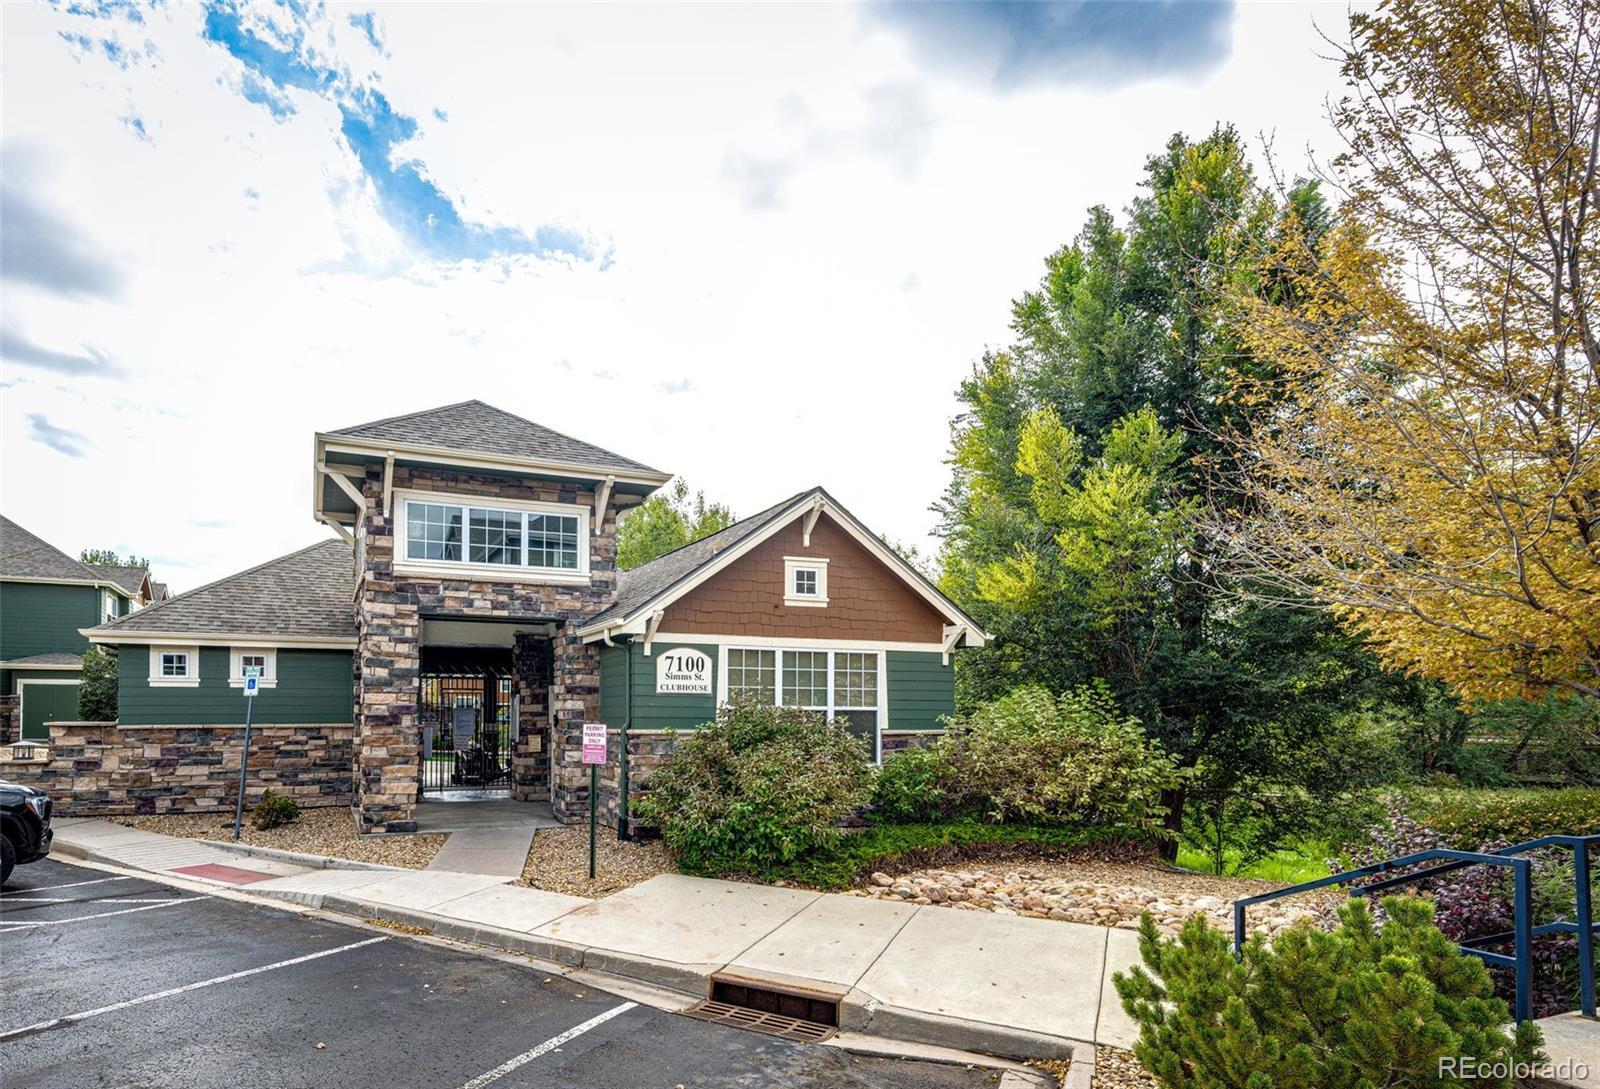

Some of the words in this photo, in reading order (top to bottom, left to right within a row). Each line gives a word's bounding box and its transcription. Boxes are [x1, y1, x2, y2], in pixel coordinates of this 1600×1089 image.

[664, 655, 705, 673] 7100
[665, 672, 692, 680] Simms
[694, 673, 705, 681] St.
[660, 683, 709, 692] CLUBHOUSE
